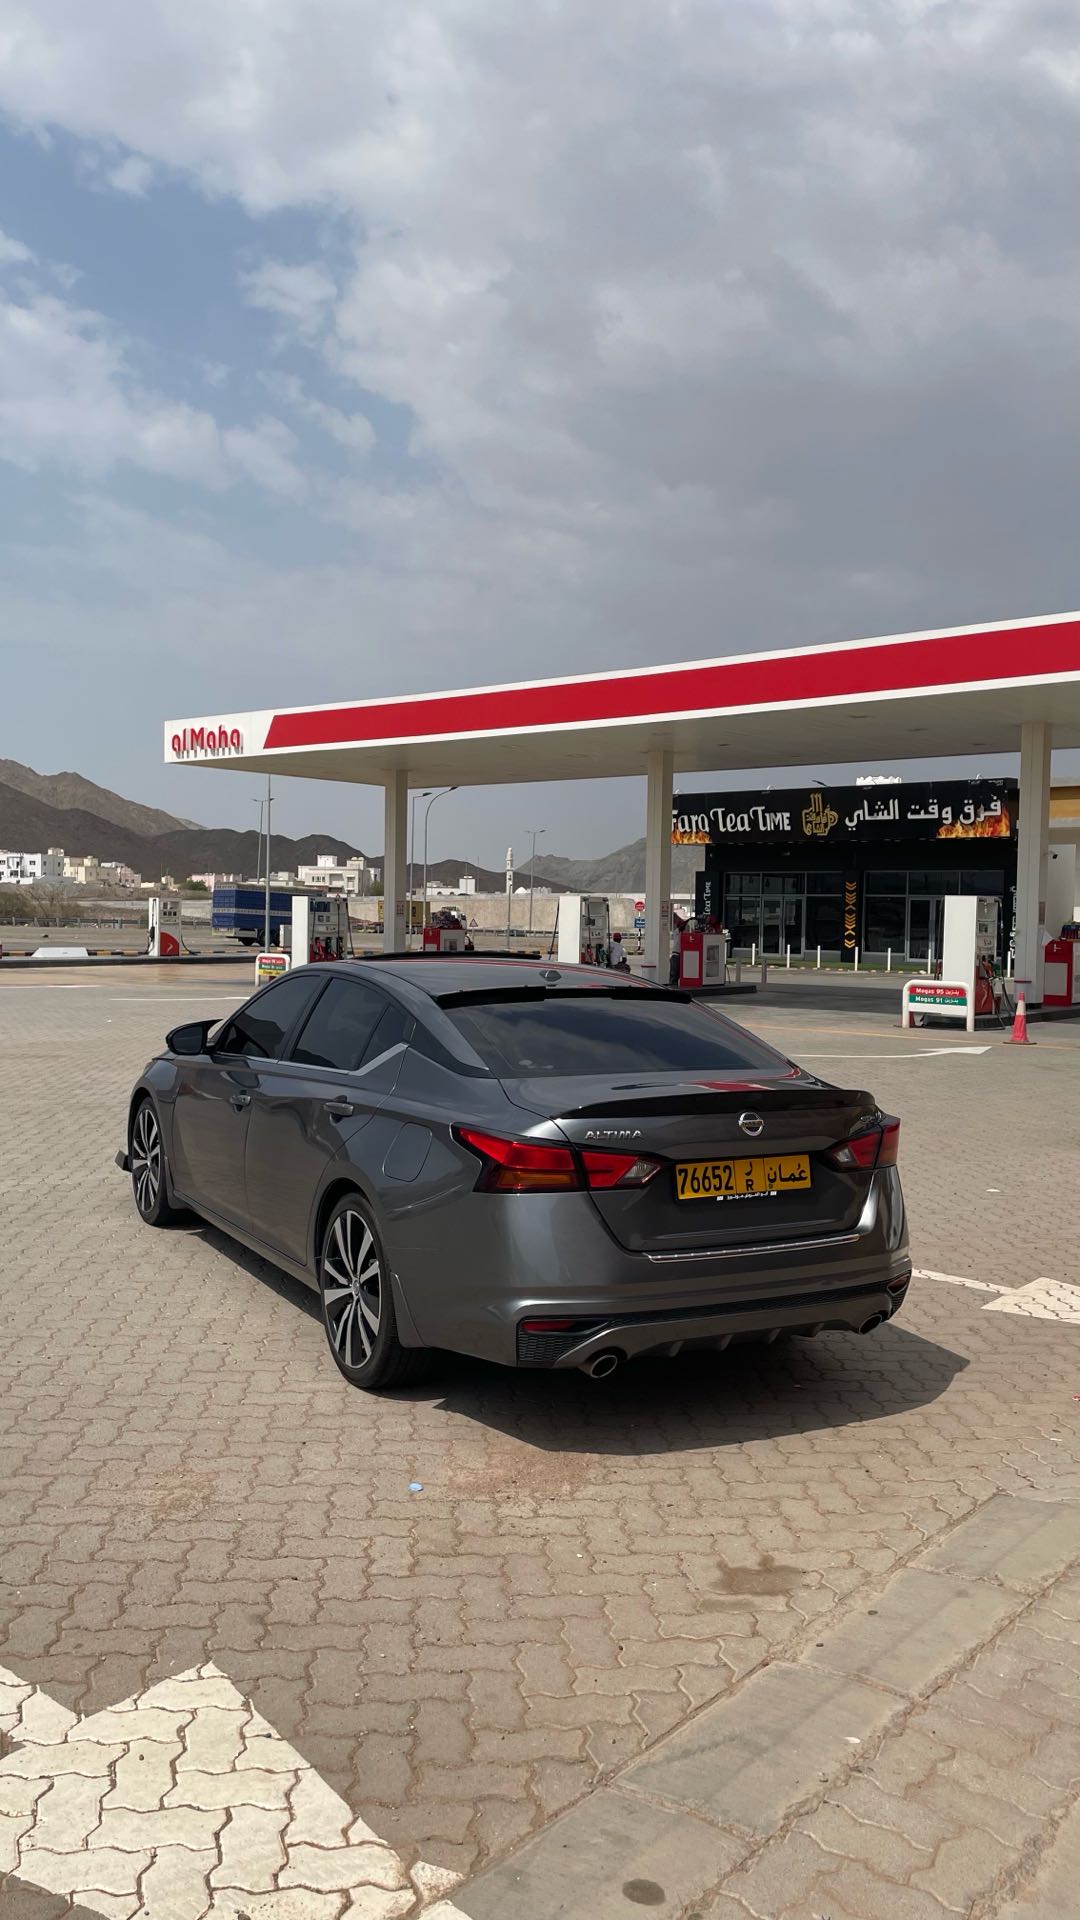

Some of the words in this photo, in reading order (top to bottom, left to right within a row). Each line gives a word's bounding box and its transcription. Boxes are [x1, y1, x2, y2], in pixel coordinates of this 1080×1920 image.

[710, 808, 750, 833] Tea
[845, 798, 899, 831] الشاي
[907, 799, 953, 825] وقت
[959, 795, 1001, 825] فرق
[584, 1130, 643, 1140] ALTIMA
[678, 1165, 734, 1195] 76652
[745, 1161, 753, 1176] ر
[745, 1179, 754, 1191] R
